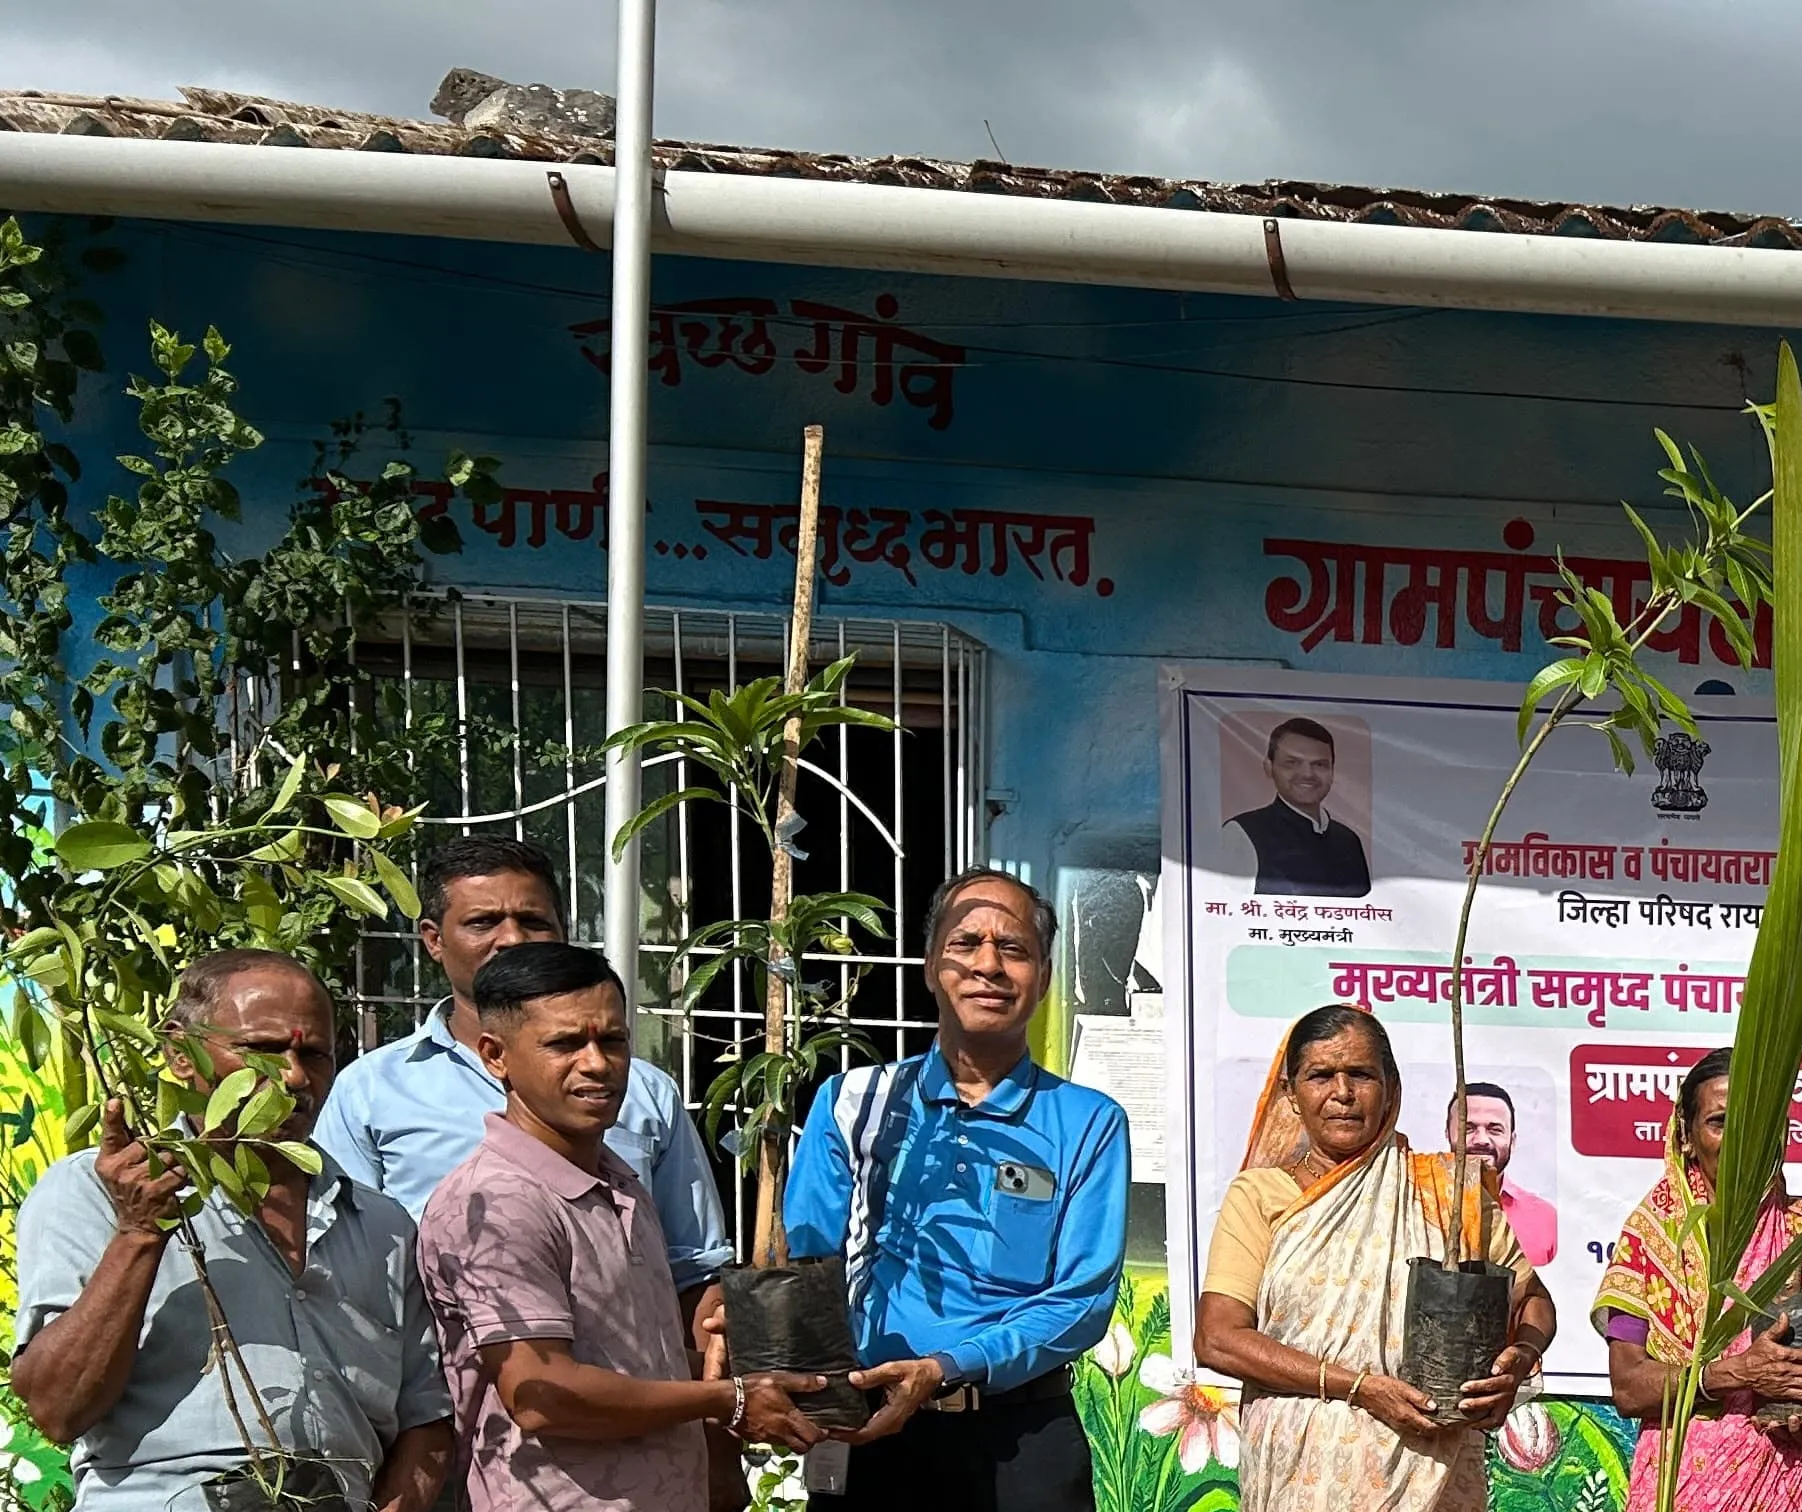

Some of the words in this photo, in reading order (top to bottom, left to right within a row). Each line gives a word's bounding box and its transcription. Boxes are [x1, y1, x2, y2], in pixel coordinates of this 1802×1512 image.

[790, 293, 966, 430] गांव
[1461, 832, 1617, 880] ग्रामविकास
[1622, 846, 1644, 881] व
[1649, 838, 1780, 886] पंचायतरा
[1205, 901, 1233, 917] मा.
[1240, 900, 1267, 917] श्री.
[1274, 900, 1308, 921] देवेंद्र
[1313, 904, 1392, 922] फडणवीस
[1558, 890, 1630, 928] जिल्हा
[1640, 894, 1713, 929] परिषद
[1719, 904, 1764, 928] राय
[1248, 928, 1273, 941] मा.
[1278, 926, 1353, 946] मुख्यमंत्री
[1329, 956, 1521, 1013] मुख्यमंत्री
